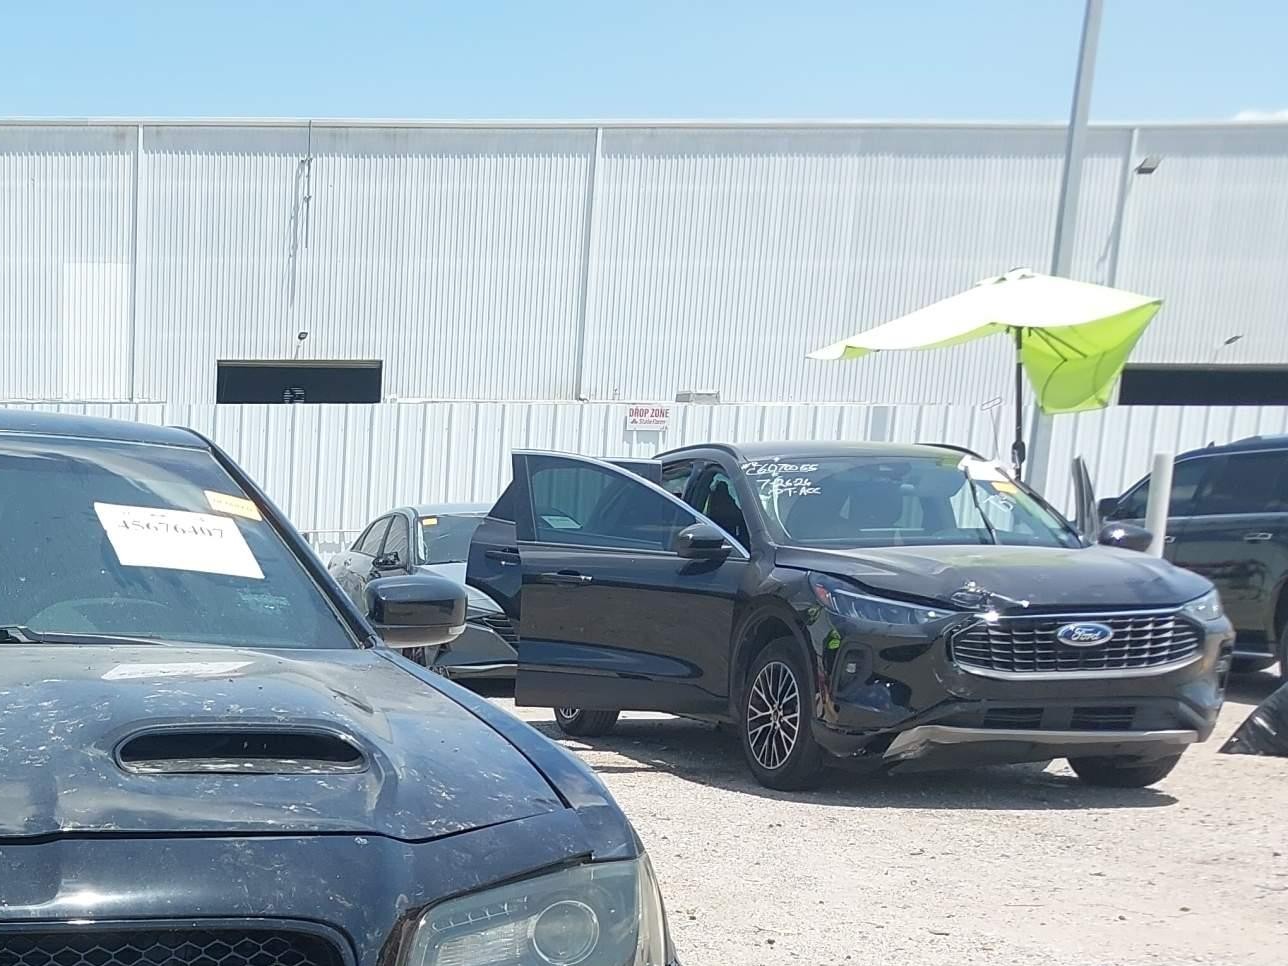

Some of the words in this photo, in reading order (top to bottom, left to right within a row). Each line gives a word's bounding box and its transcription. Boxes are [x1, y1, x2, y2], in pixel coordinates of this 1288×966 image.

[629, 408, 649, 417] DROP
[650, 408, 670, 418] ZONE
[1072, 627, 1102, 641] Ford
